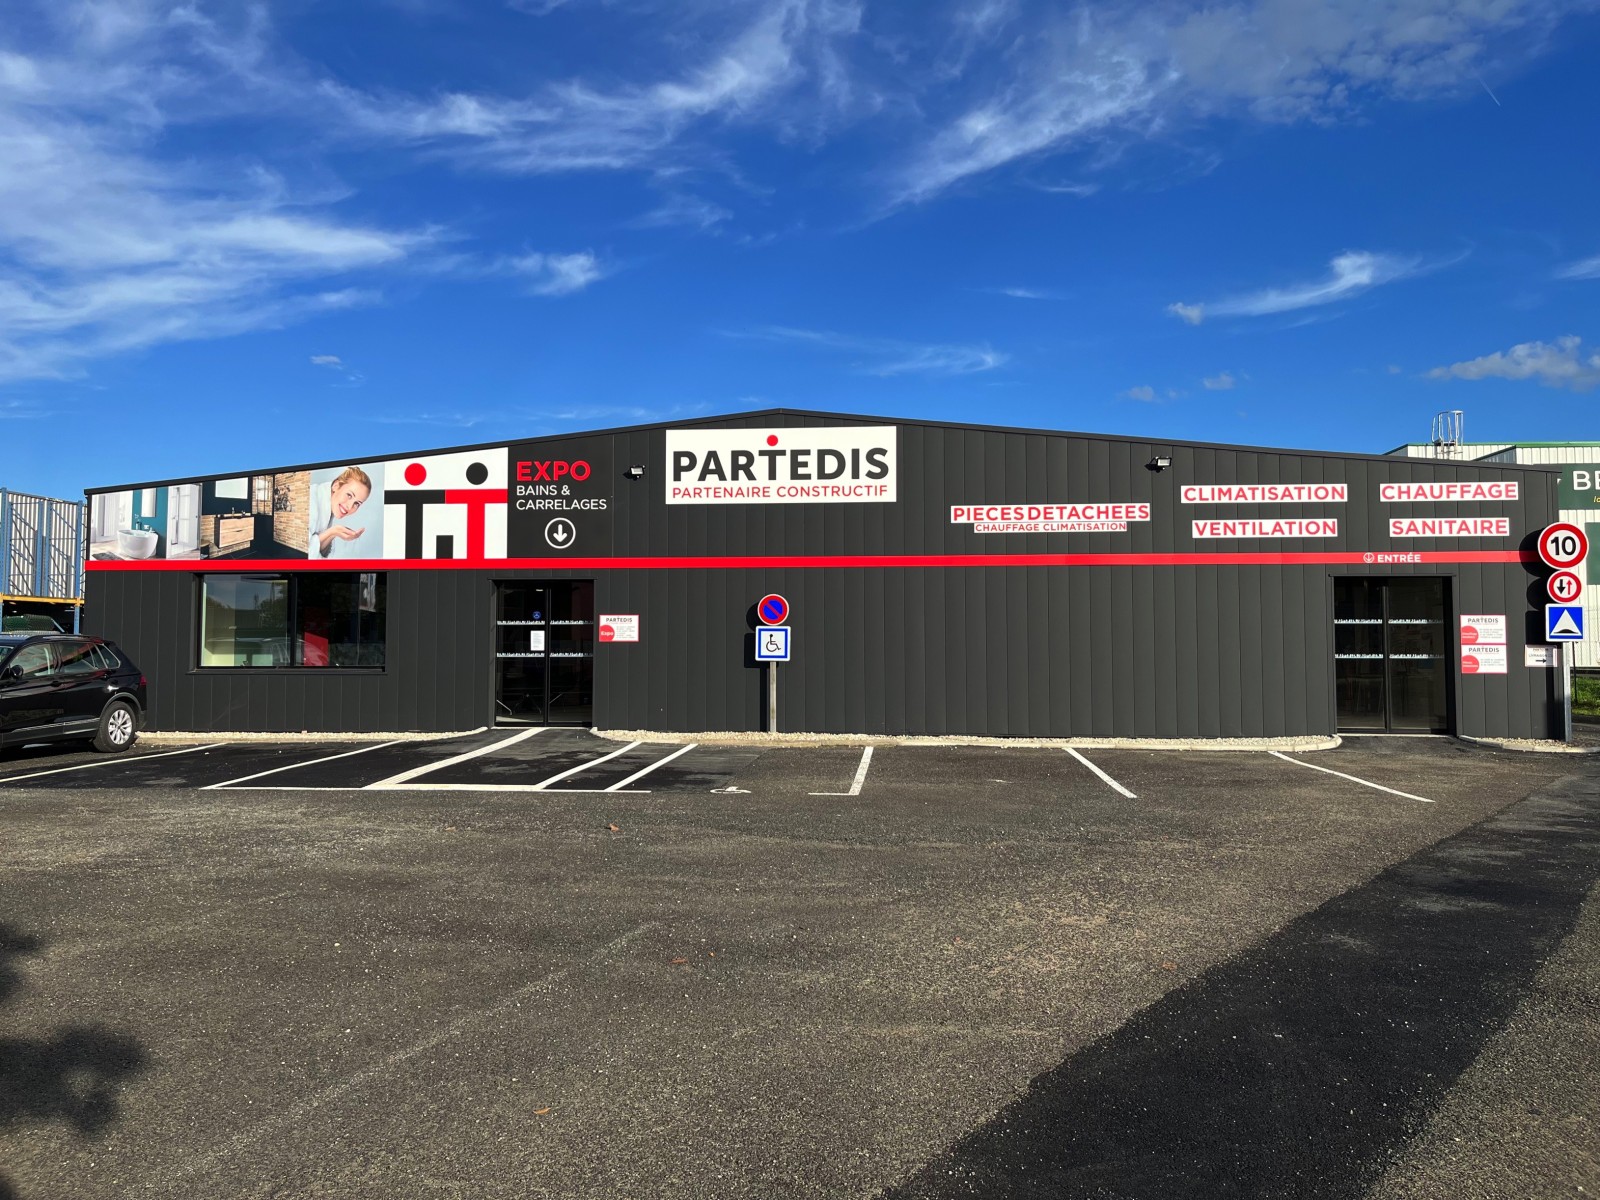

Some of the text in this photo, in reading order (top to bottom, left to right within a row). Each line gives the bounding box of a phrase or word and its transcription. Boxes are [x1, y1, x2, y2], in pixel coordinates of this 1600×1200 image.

[516, 460, 591, 481] EXPO
[673, 446, 889, 482] PARTEDIS
[1572, 470, 1600, 491] B
[516, 485, 571, 496] BAINS &
[672, 485, 888, 499] PARTENAIRE CONSTRUCTIF
[1183, 485, 1346, 502] CLIMATISATION
[1381, 483, 1517, 500] CHAUFFAGE
[516, 499, 607, 510] CARRELAGES
[953, 504, 1149, 522] PIECES DETACHEES
[975, 522, 1126, 532] CHAUFFAGE CLIMATISATION
[1194, 520, 1337, 537] VENTILATION
[1391, 518, 1508, 536] SANITAIRE
[1550, 536, 1577, 556] 10
[1377, 552, 1421, 563] ENTRÉE
